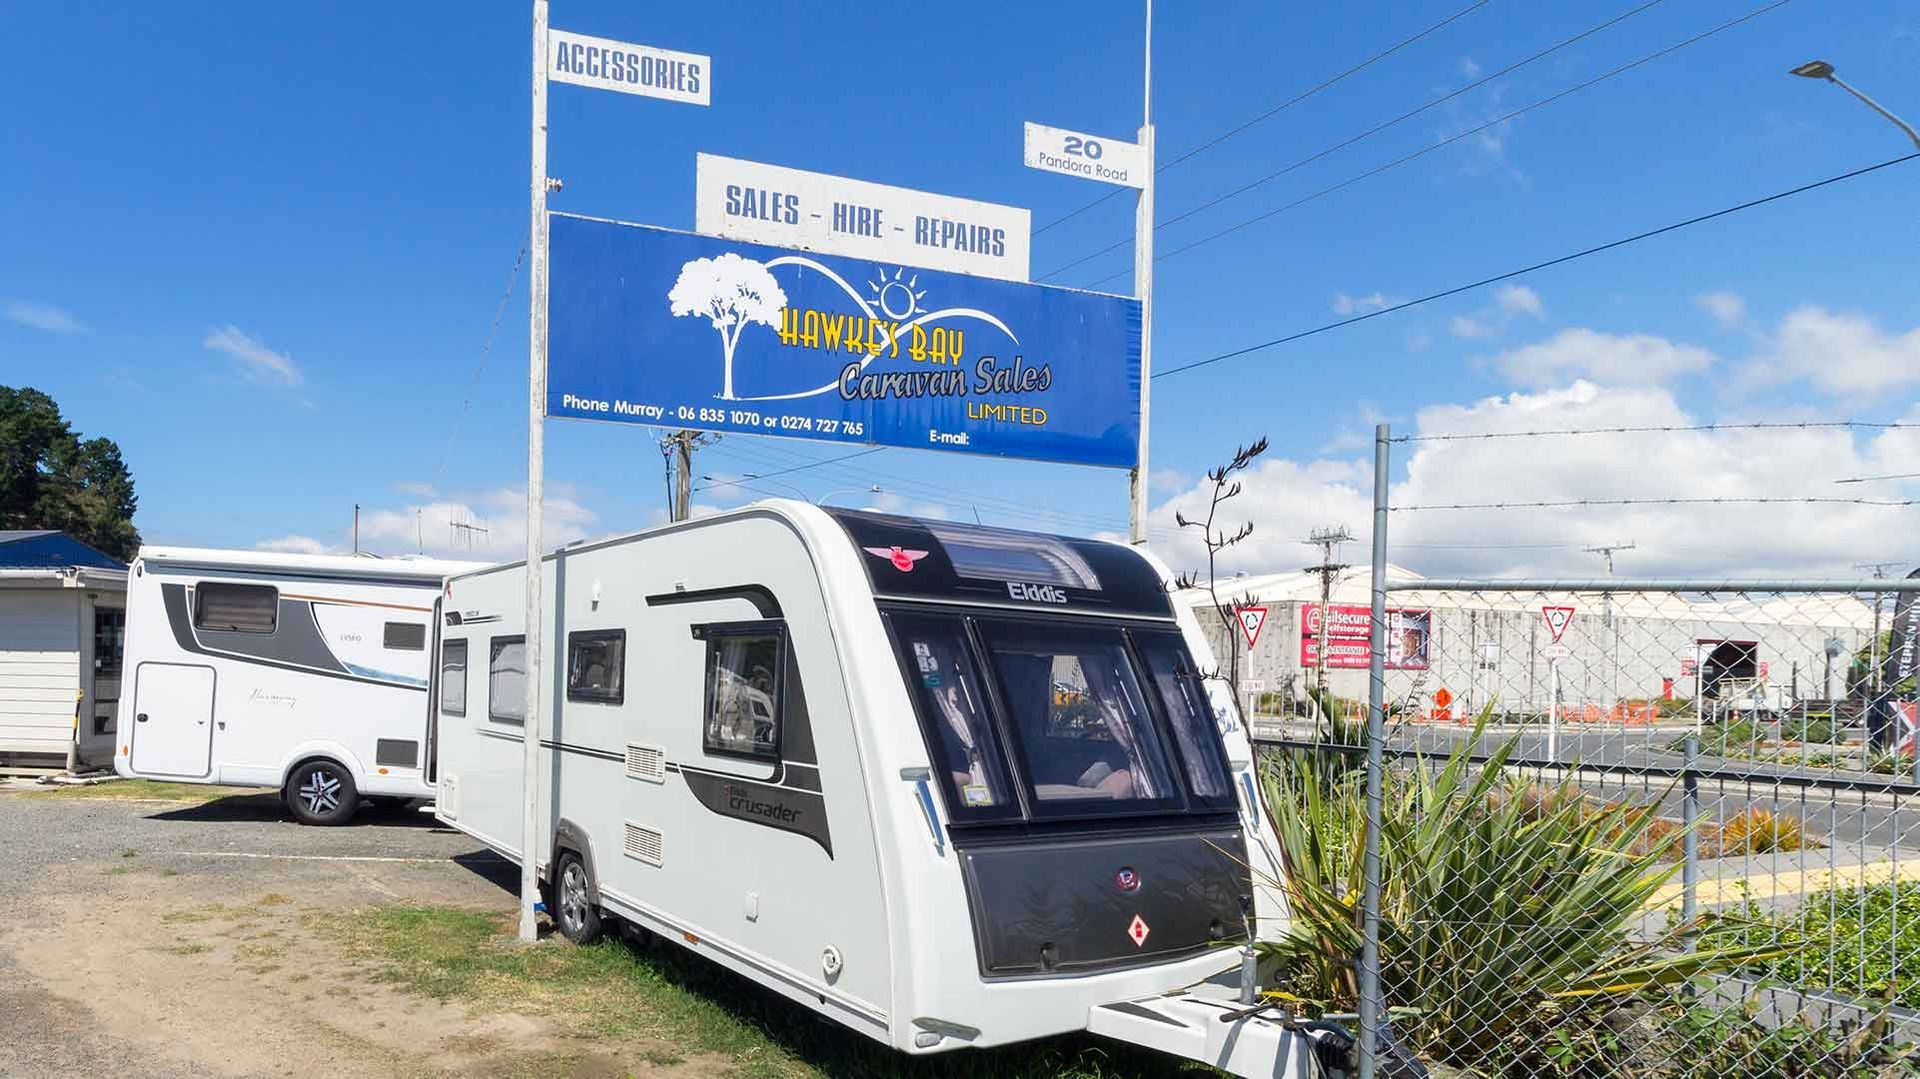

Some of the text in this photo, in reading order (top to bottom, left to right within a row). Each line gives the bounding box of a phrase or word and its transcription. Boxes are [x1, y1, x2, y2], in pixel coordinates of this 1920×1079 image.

[556, 41, 701, 94] ACCESSORIES
[1063, 136, 1103, 160] 20
[1039, 151, 1128, 182] Pandora Road
[726, 184, 800, 225] SALES
[833, 201, 884, 239] HIRE
[915, 215, 1006, 257] REPAIRS
[778, 306, 966, 367] HAWKE'S BAY
[838, 355, 1054, 401] Caravan Sales
[562, 393, 610, 412] Phone
[614, 399, 665, 420] Murray
[678, 405, 696, 421] 06
[699, 407, 725, 424] 835
[730, 410, 760, 427] 1070
[763, 416, 778, 428] or
[780, 416, 812, 432] 0274
[816, 418, 838, 434] 727
[842, 420, 864, 436] 765
[967, 400, 1049, 426] LIMITED
[929, 429, 970, 446] E-mail:
[1006, 581, 1068, 604] Elddis
[1326, 609, 1371, 625] ailsecure
[1327, 624, 1370, 635] elfstorage
[1898, 625, 1917, 678] STEPHN
[729, 797, 803, 823] crusader
